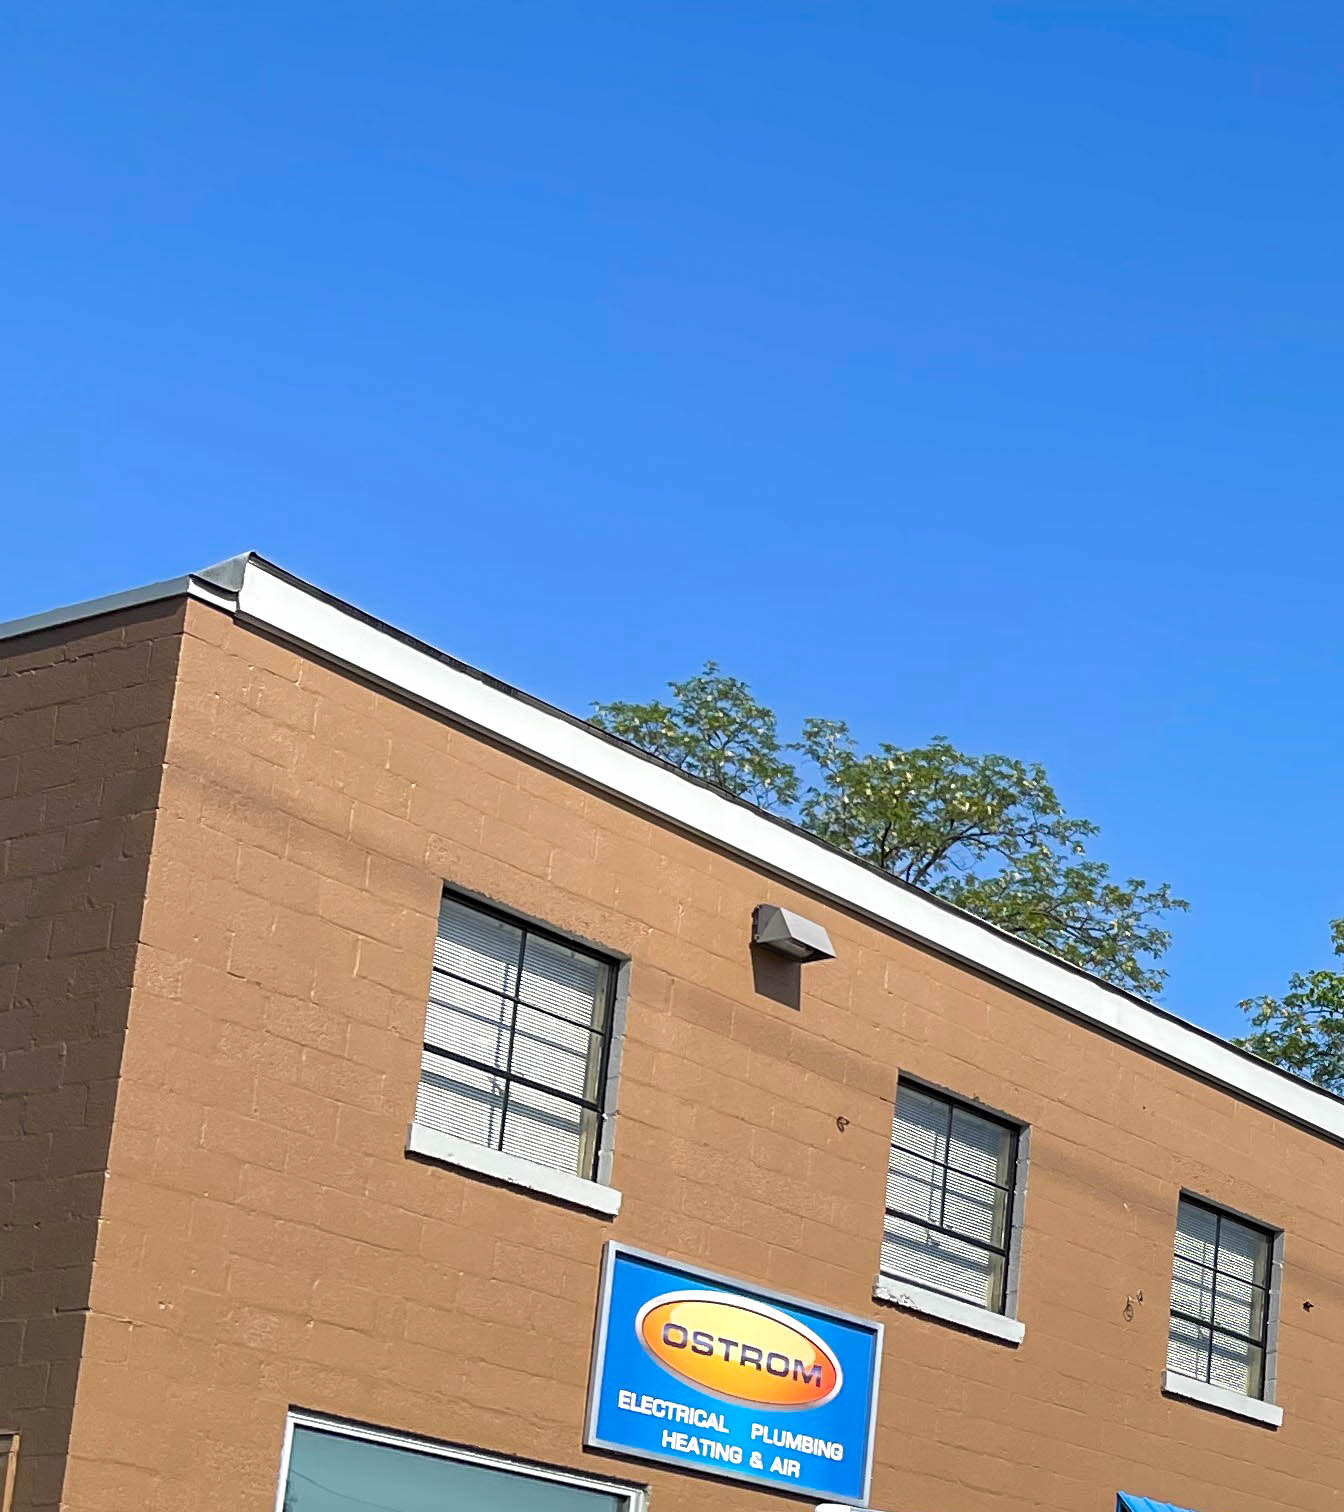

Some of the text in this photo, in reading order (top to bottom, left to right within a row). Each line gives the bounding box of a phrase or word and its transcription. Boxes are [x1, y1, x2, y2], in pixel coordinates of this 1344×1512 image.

[662, 1323, 822, 1387] OSTROM
[618, 1389, 843, 1461] ELECTRICAL PLUMBING
[661, 1430, 801, 1478] HEATING & AIR
